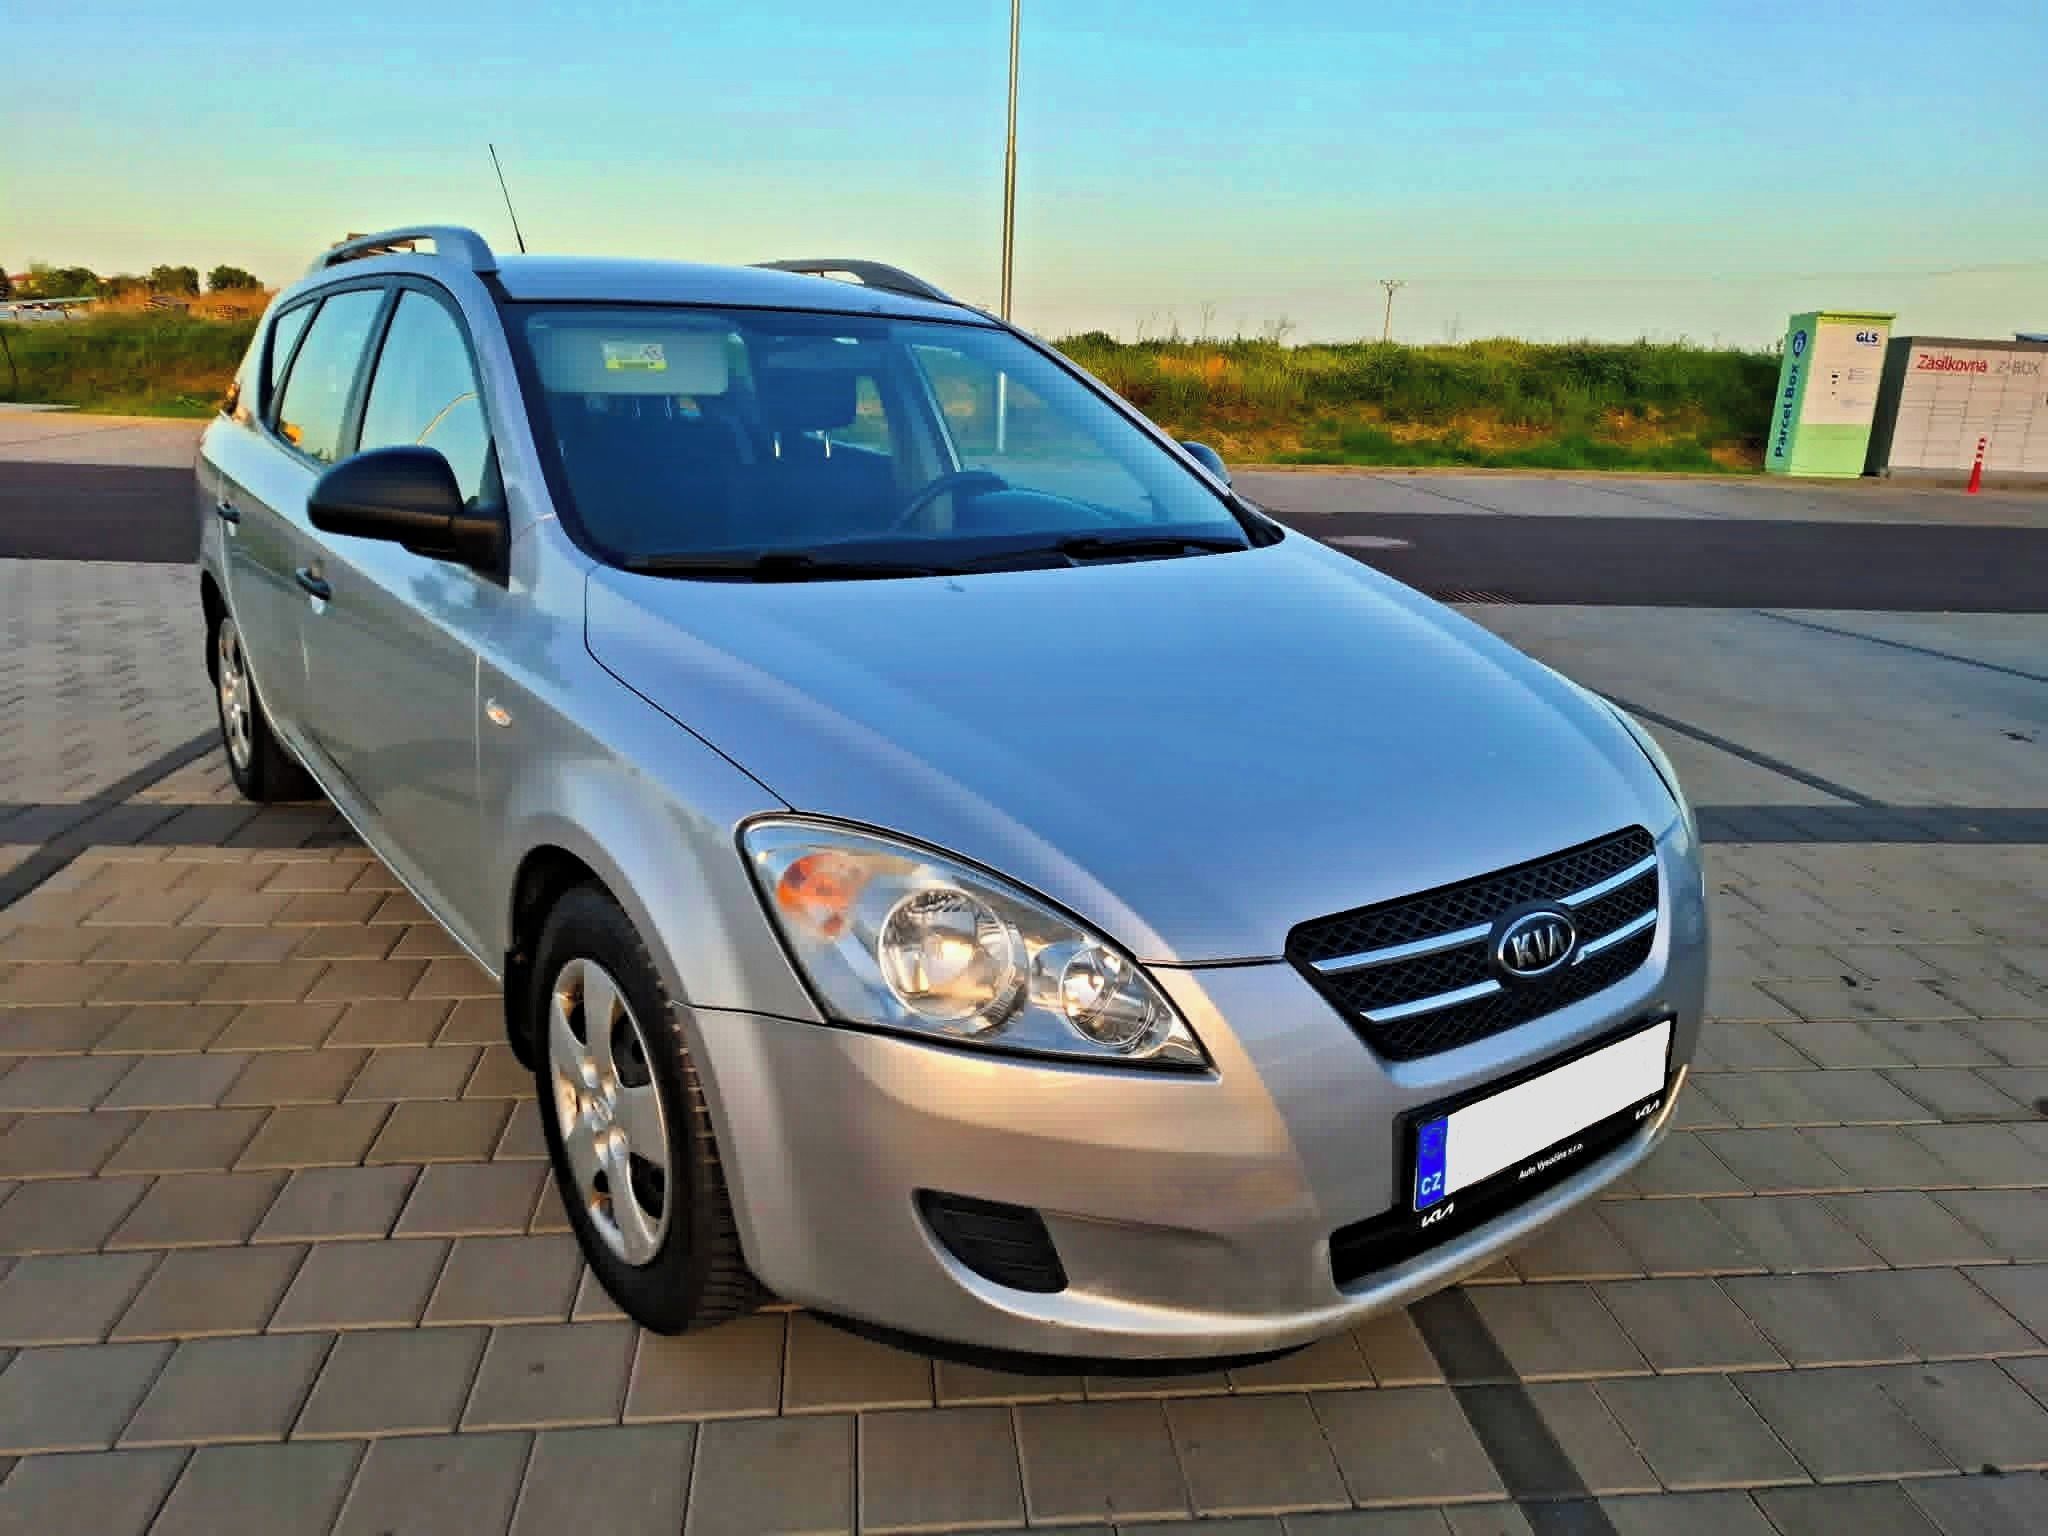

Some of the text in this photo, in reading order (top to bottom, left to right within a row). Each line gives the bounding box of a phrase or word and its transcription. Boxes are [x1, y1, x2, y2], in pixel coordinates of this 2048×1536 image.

[1855, 331, 1880, 343] GLS
[1774, 363, 1799, 457] Parcel Box
[1518, 1165, 1536, 1180] Auto
[1421, 1171, 1442, 1195] CZ
